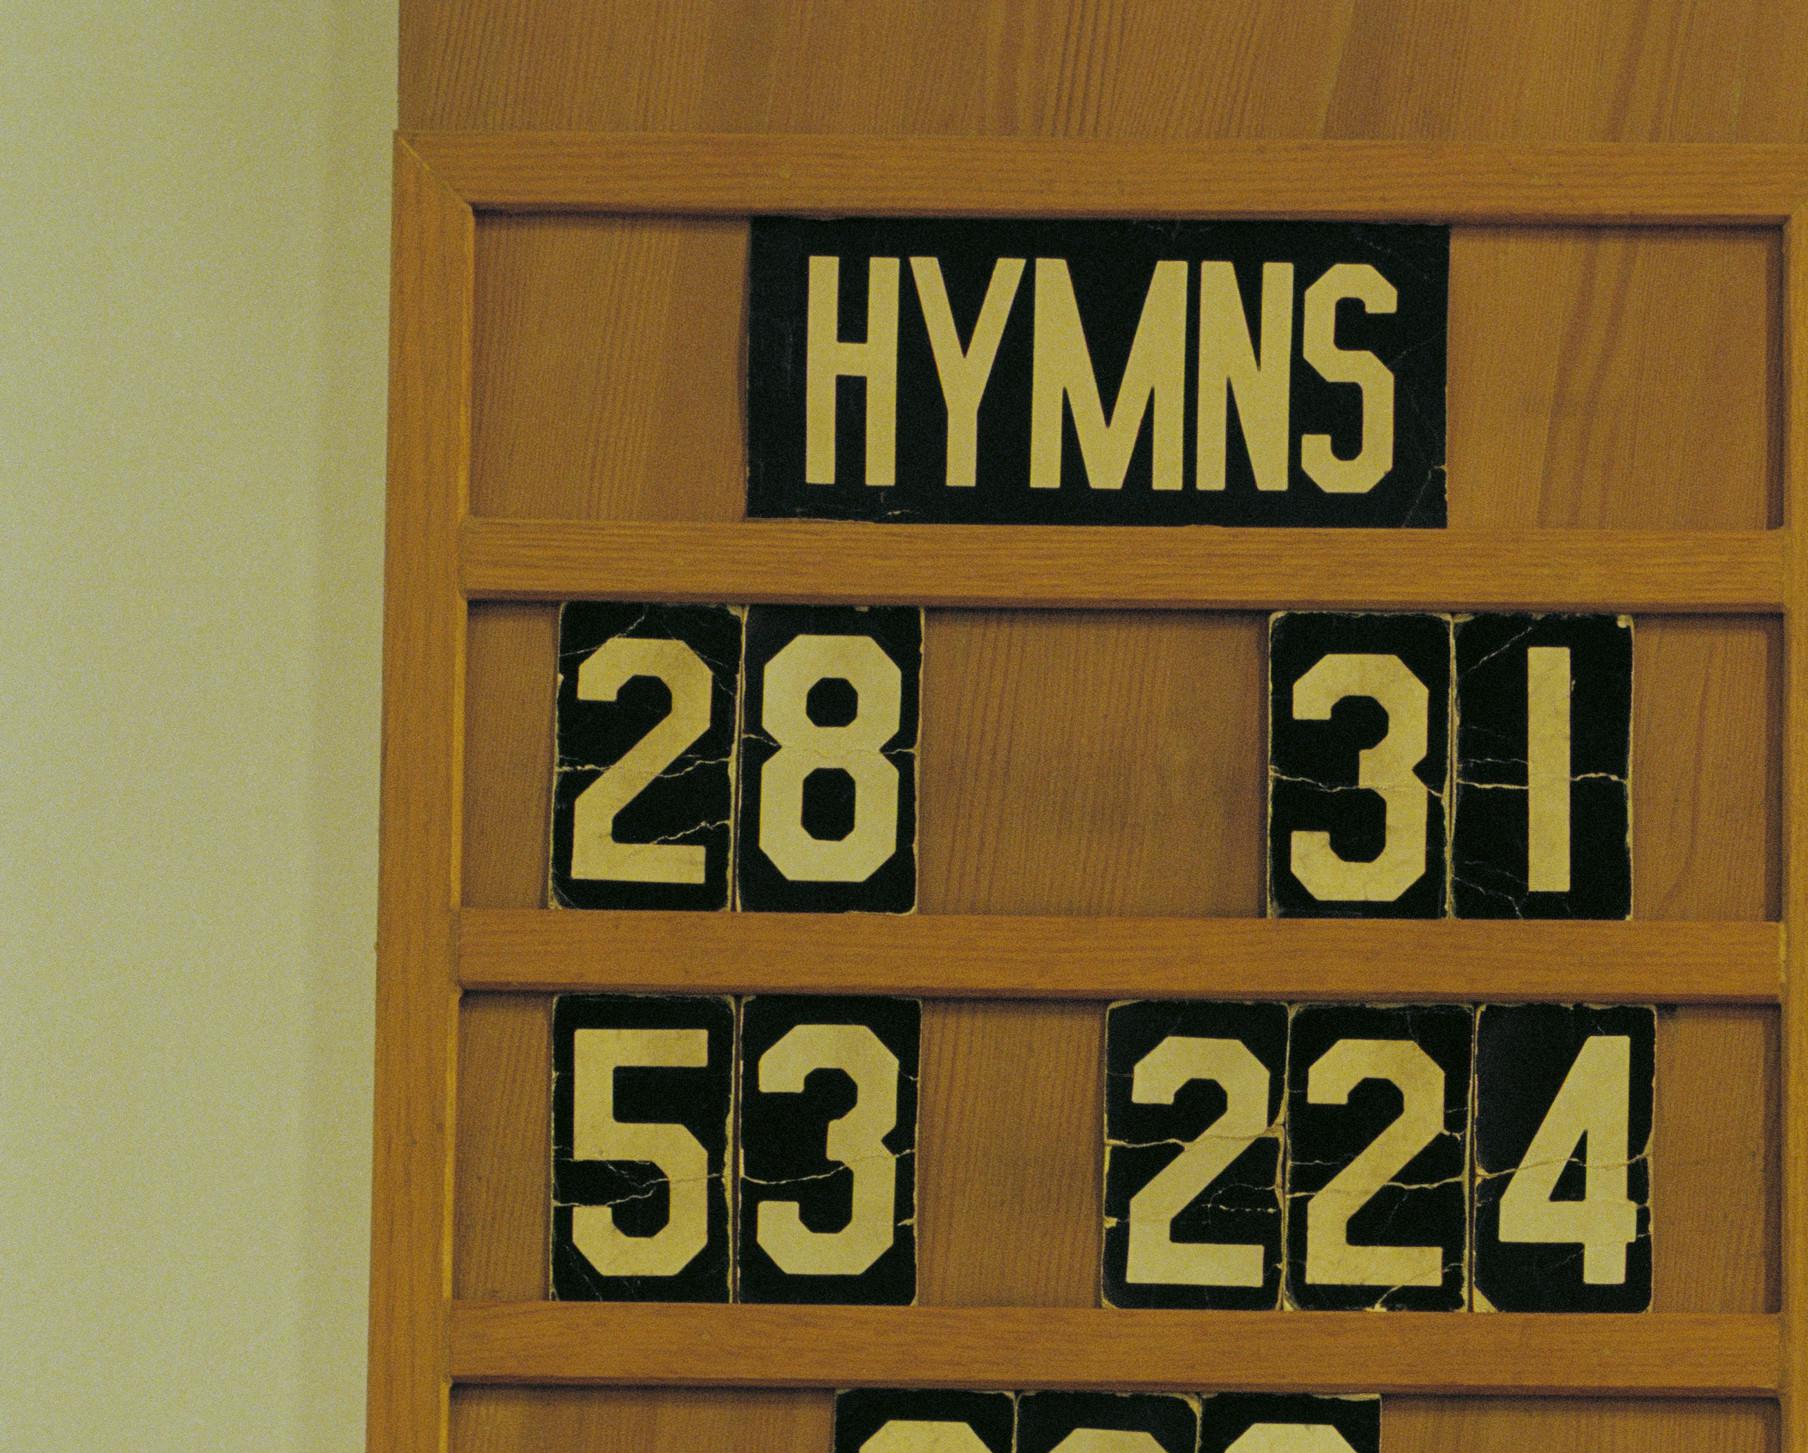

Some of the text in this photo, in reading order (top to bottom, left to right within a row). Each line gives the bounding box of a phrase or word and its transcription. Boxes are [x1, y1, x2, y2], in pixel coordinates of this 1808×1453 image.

[805, 256, 1399, 494] HYMNS
[571, 635, 1572, 903] 28 31
[569, 1022, 1639, 1288] 53 224
